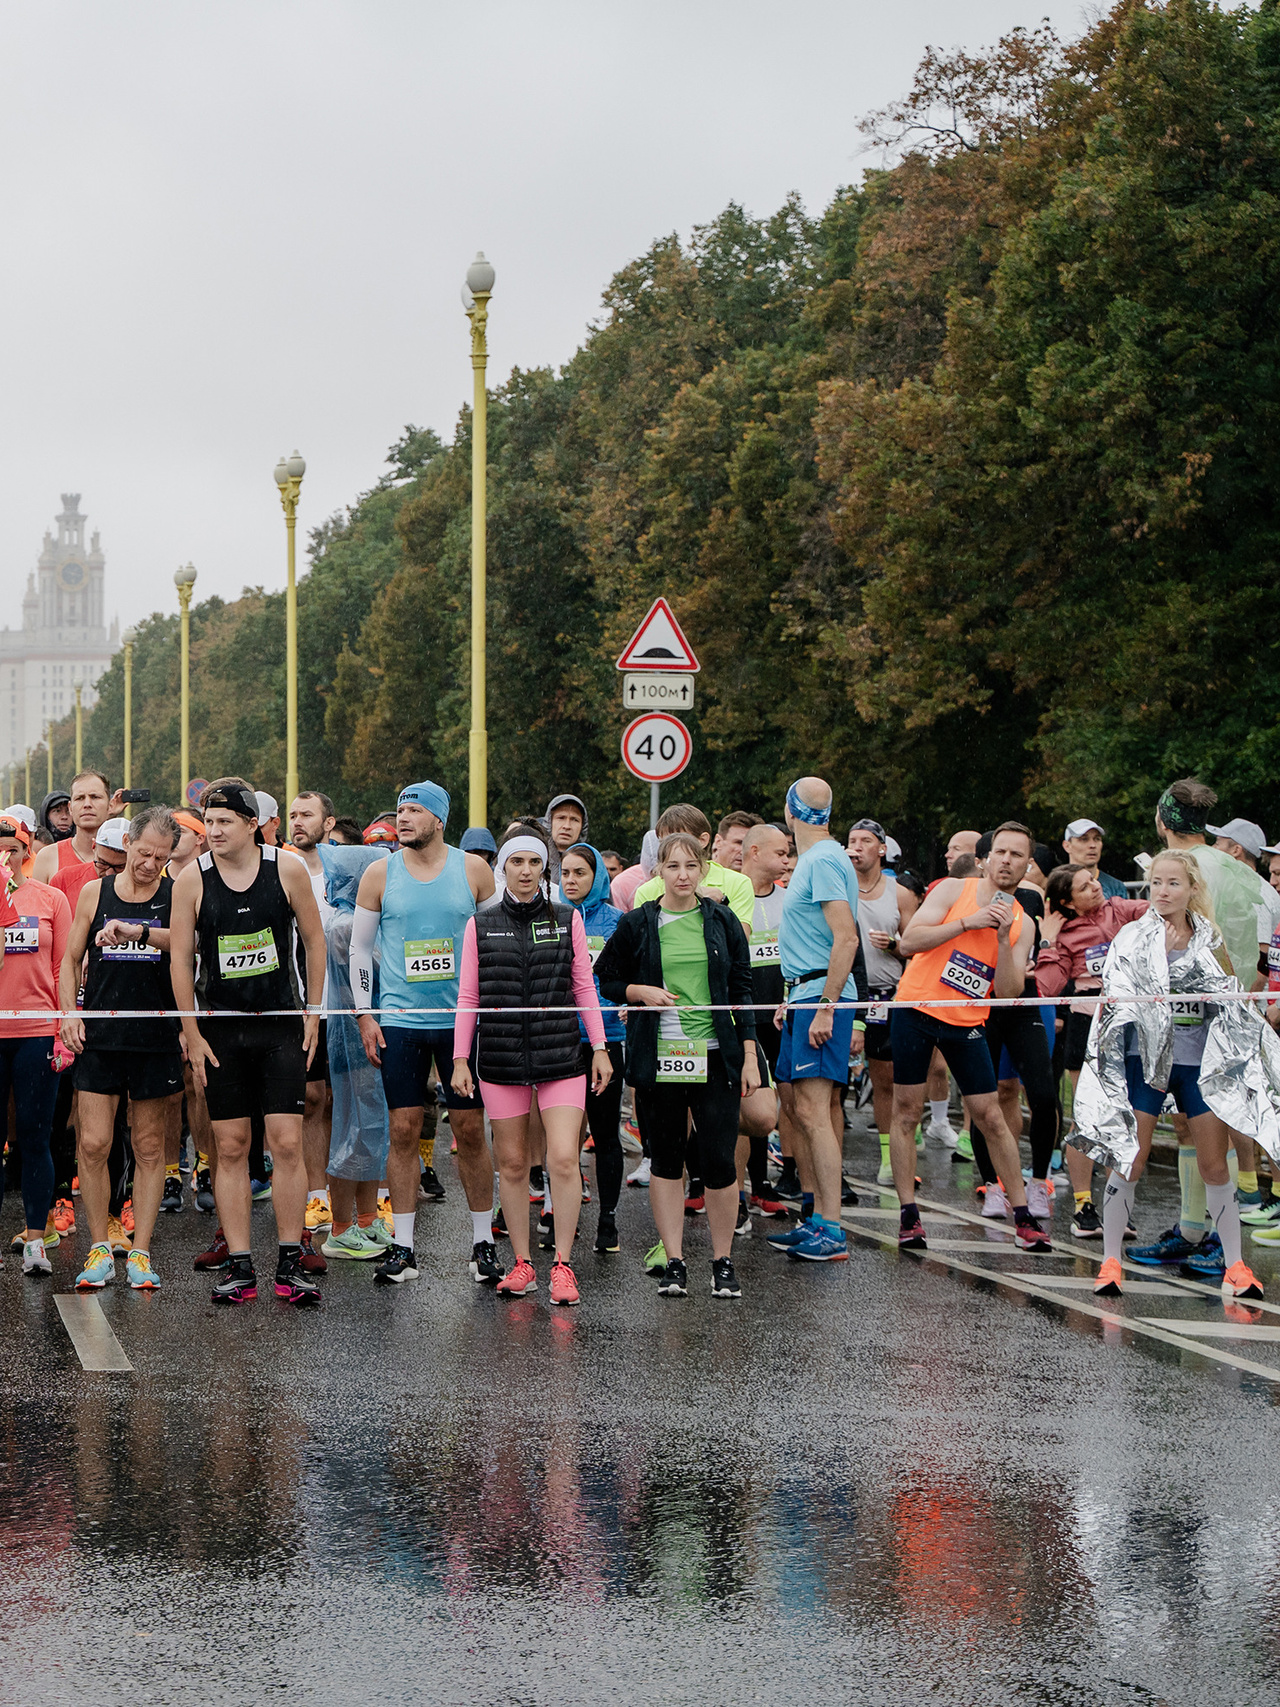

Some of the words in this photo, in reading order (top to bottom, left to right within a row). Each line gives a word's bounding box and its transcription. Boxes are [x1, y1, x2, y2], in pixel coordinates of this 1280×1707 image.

[635, 734, 676, 761] 40
[226, 951, 267, 969] 4776
[410, 957, 452, 972] 4565
[947, 967, 981, 990] 6200
